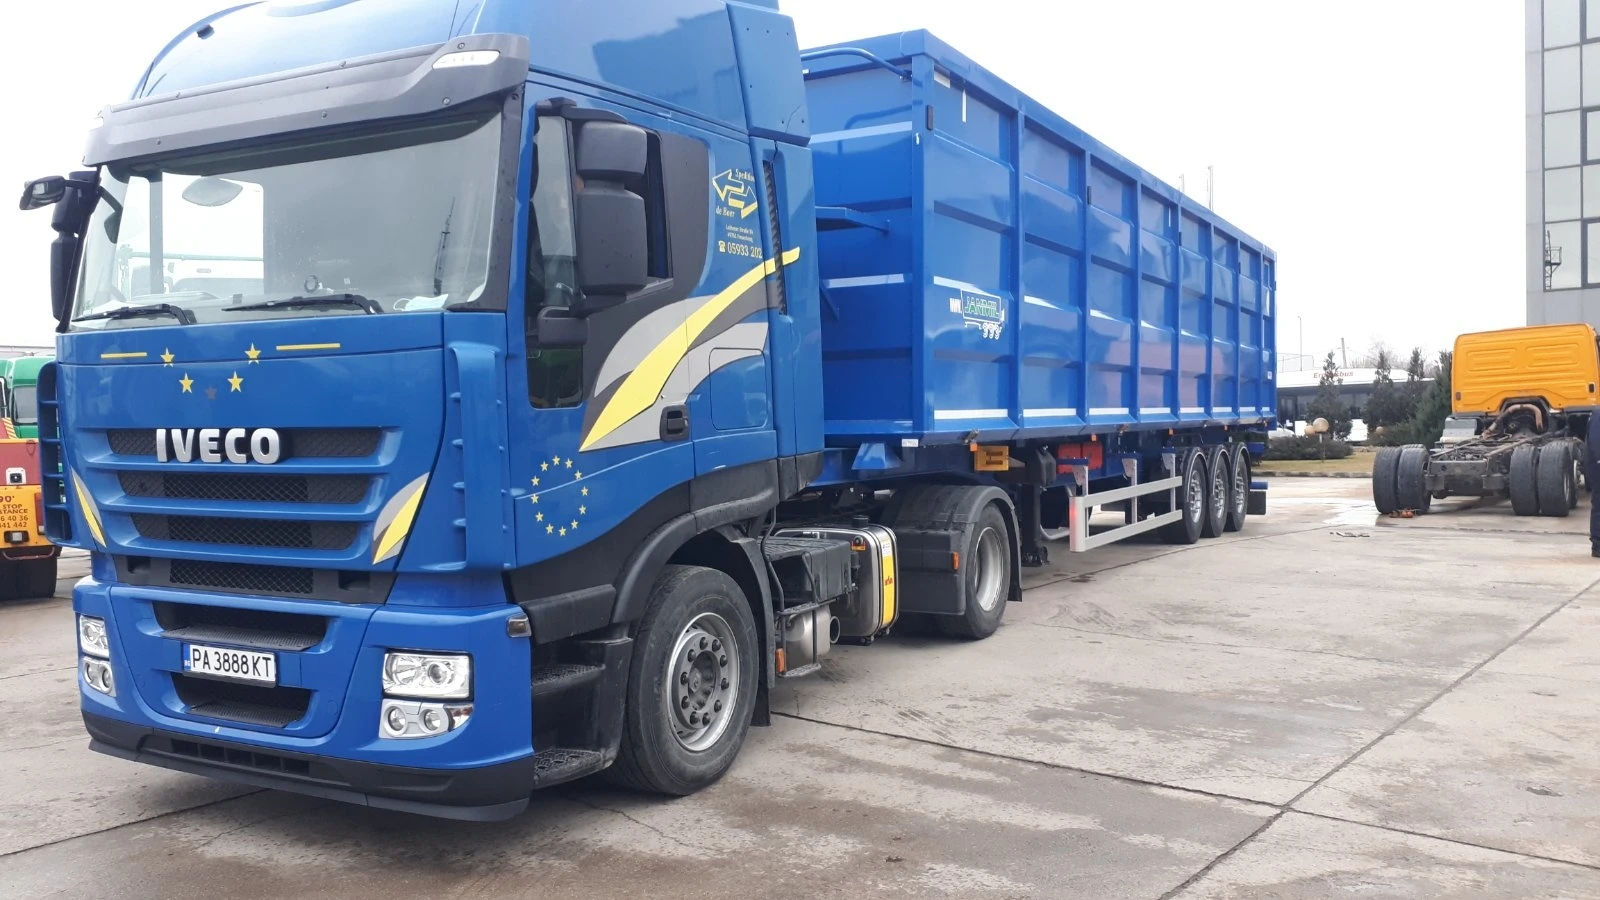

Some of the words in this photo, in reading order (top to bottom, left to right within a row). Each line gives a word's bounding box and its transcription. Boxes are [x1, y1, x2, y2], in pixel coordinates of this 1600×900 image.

[727, 242, 749, 257] 05933
[156, 427, 281, 464] IVECO
[214, 651, 249, 675] 3888
[252, 655, 272, 678] KT
